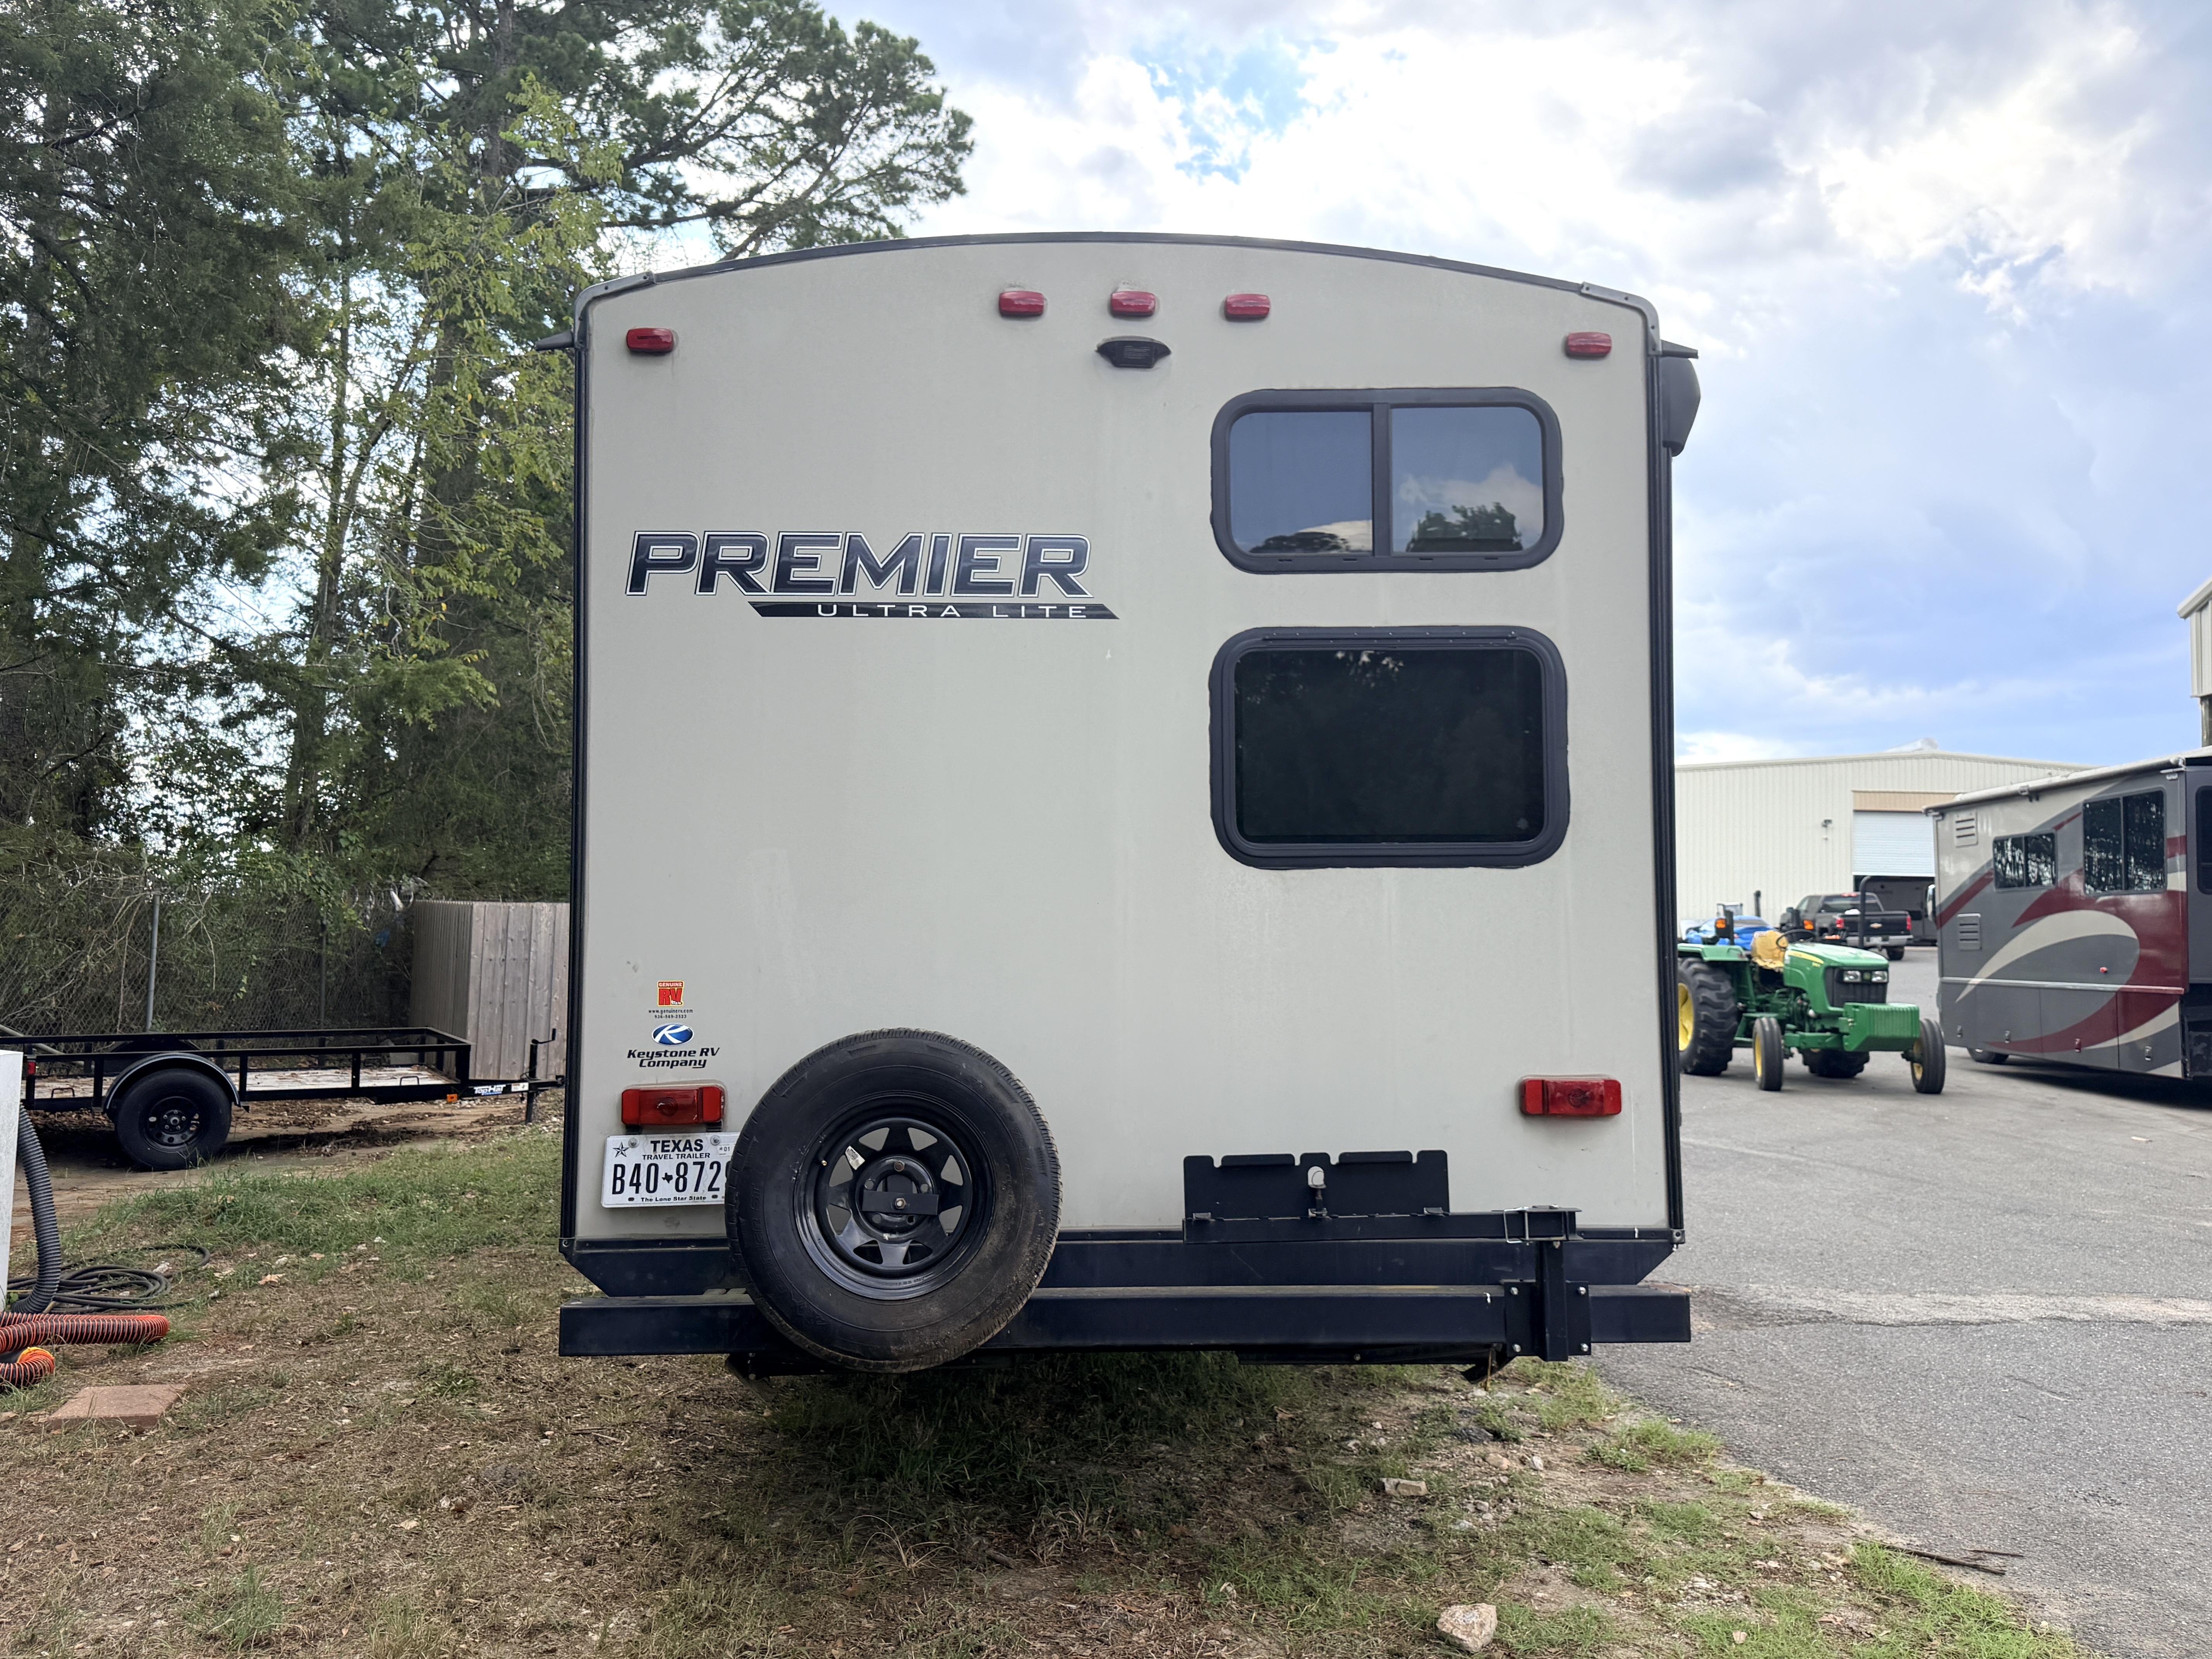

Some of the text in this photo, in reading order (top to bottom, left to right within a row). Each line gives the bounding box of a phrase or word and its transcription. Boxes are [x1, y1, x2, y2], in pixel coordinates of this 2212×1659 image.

[625, 531, 1094, 598] PREMIER
[817, 604, 1087, 618] ULTRA LITE
[658, 988, 682, 1005] RV
[627, 1047, 720, 1060] Keystone RV
[639, 1058, 707, 1069] Company
[650, 1139, 704, 1153] TEXAS
